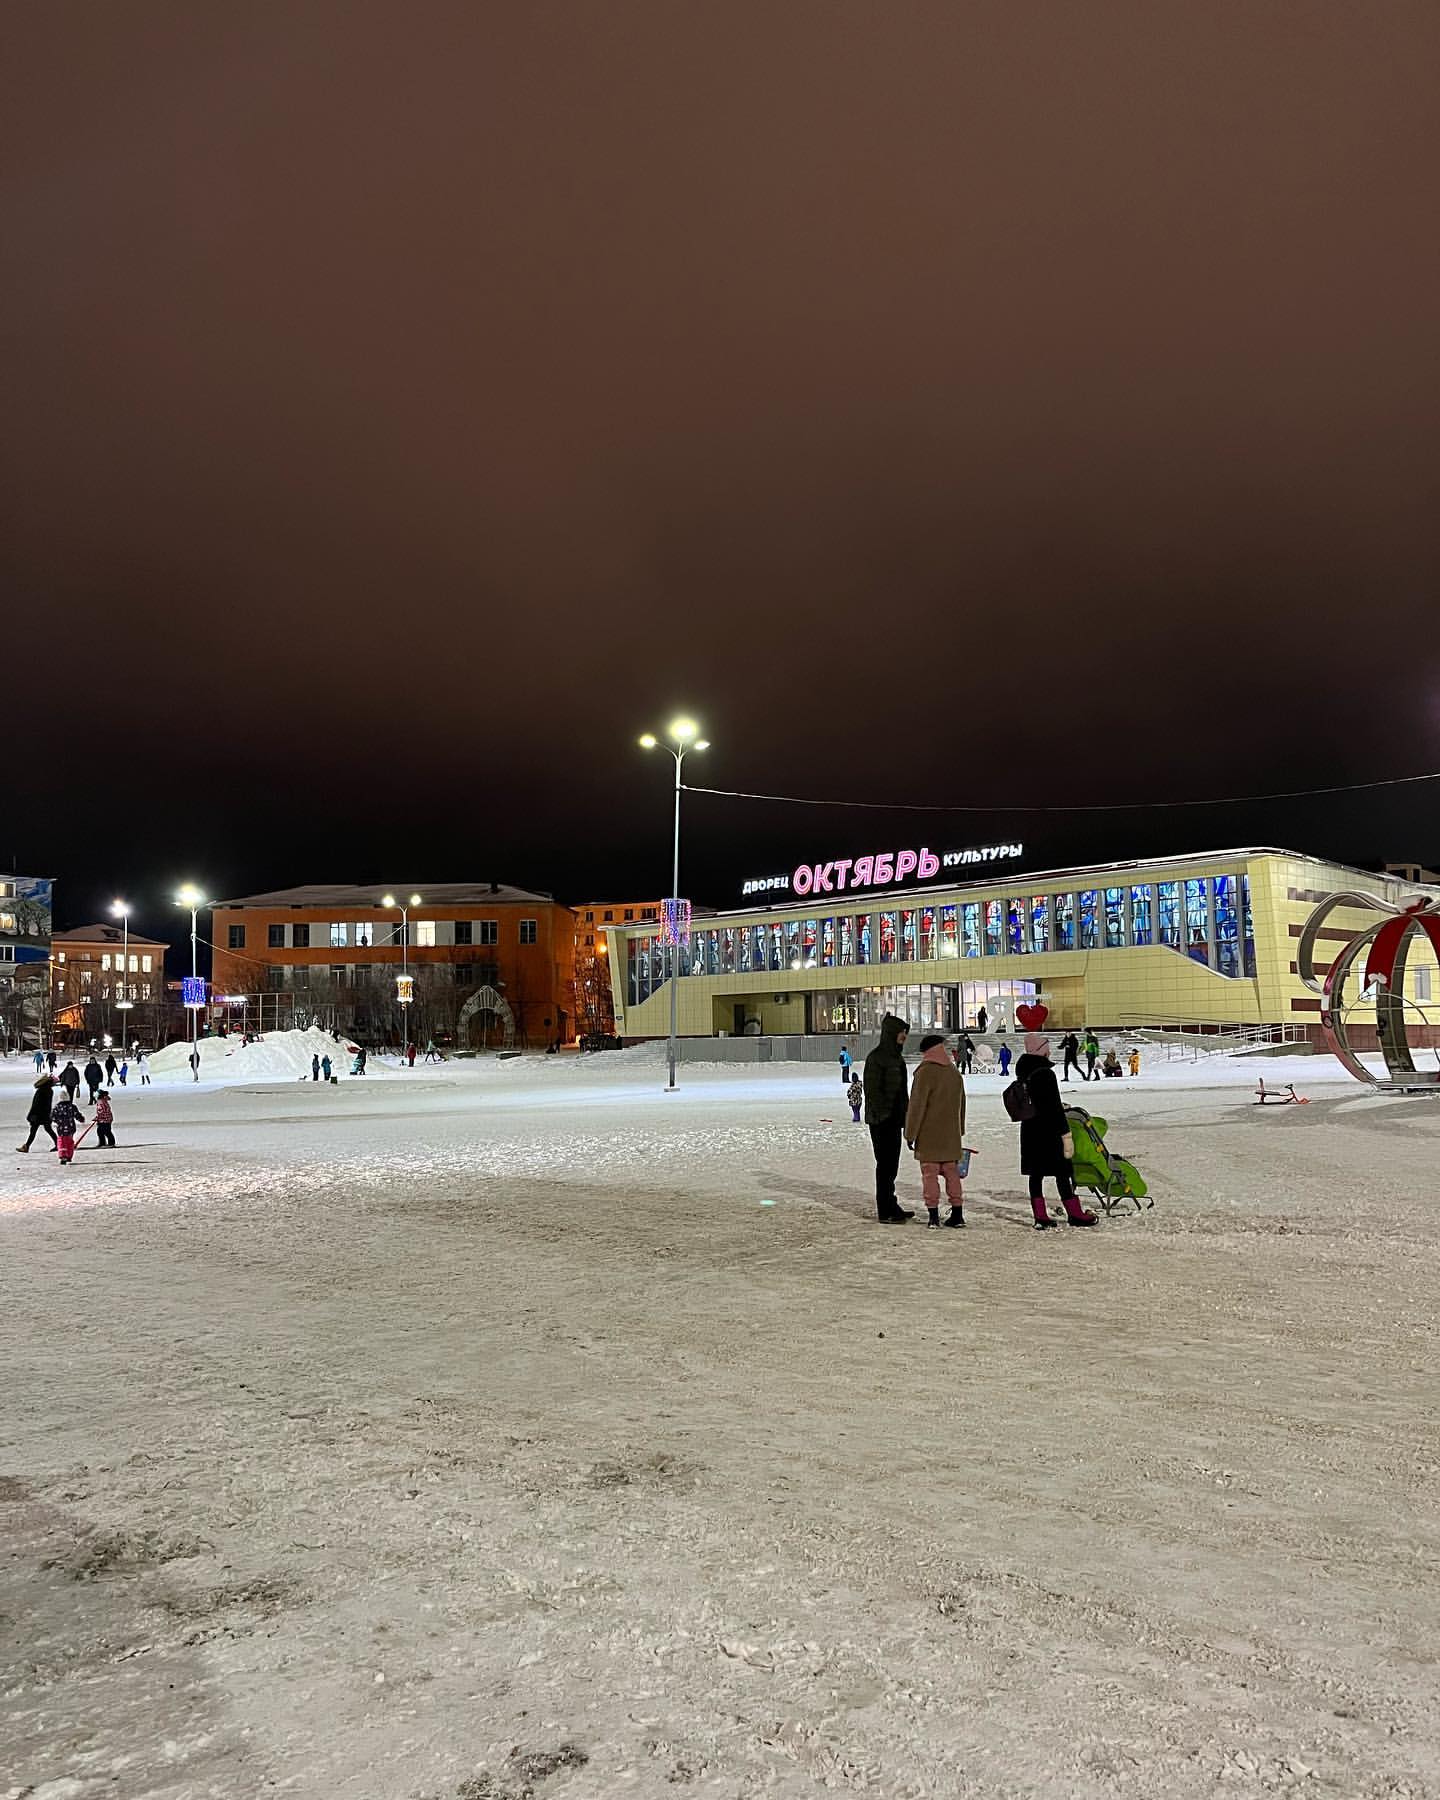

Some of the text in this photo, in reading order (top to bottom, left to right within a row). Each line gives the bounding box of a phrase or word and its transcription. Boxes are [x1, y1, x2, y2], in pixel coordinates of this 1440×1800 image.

[743, 844, 1023, 895] ДВОРЕЦ ОКТЯБРЬ КУЛЬТУРЫ
[985, 995, 1015, 1033] Я
